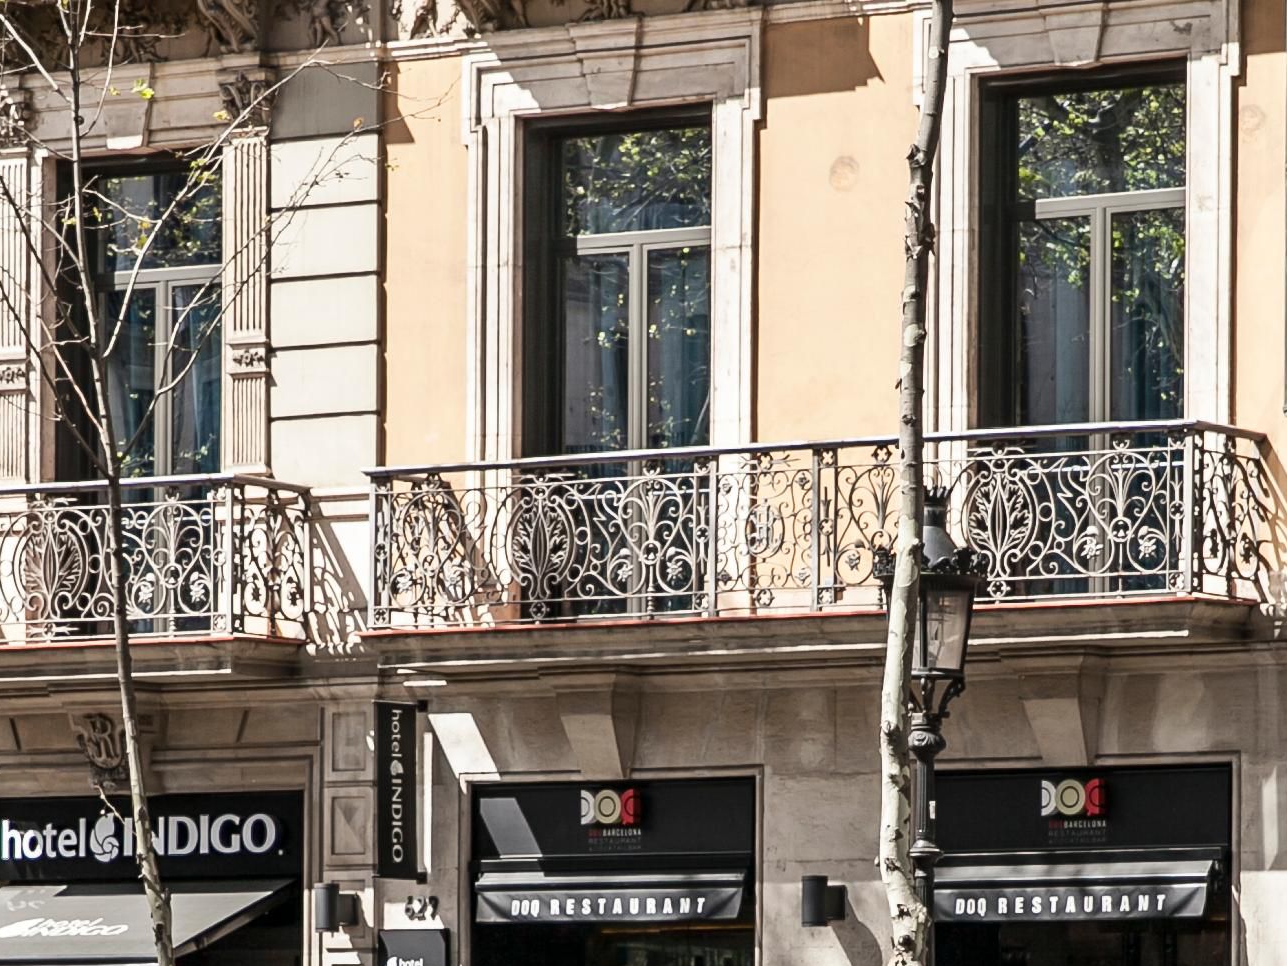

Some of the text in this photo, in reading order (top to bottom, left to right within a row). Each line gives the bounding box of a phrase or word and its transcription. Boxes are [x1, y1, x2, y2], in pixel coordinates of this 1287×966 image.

[391, 709, 404, 863] hotel INDIGO
[1, 817, 87, 861] hotel
[511, 897, 706, 917] DOQ RESTAURANT
[955, 894, 1167, 917] DOQ RESTAURANT
